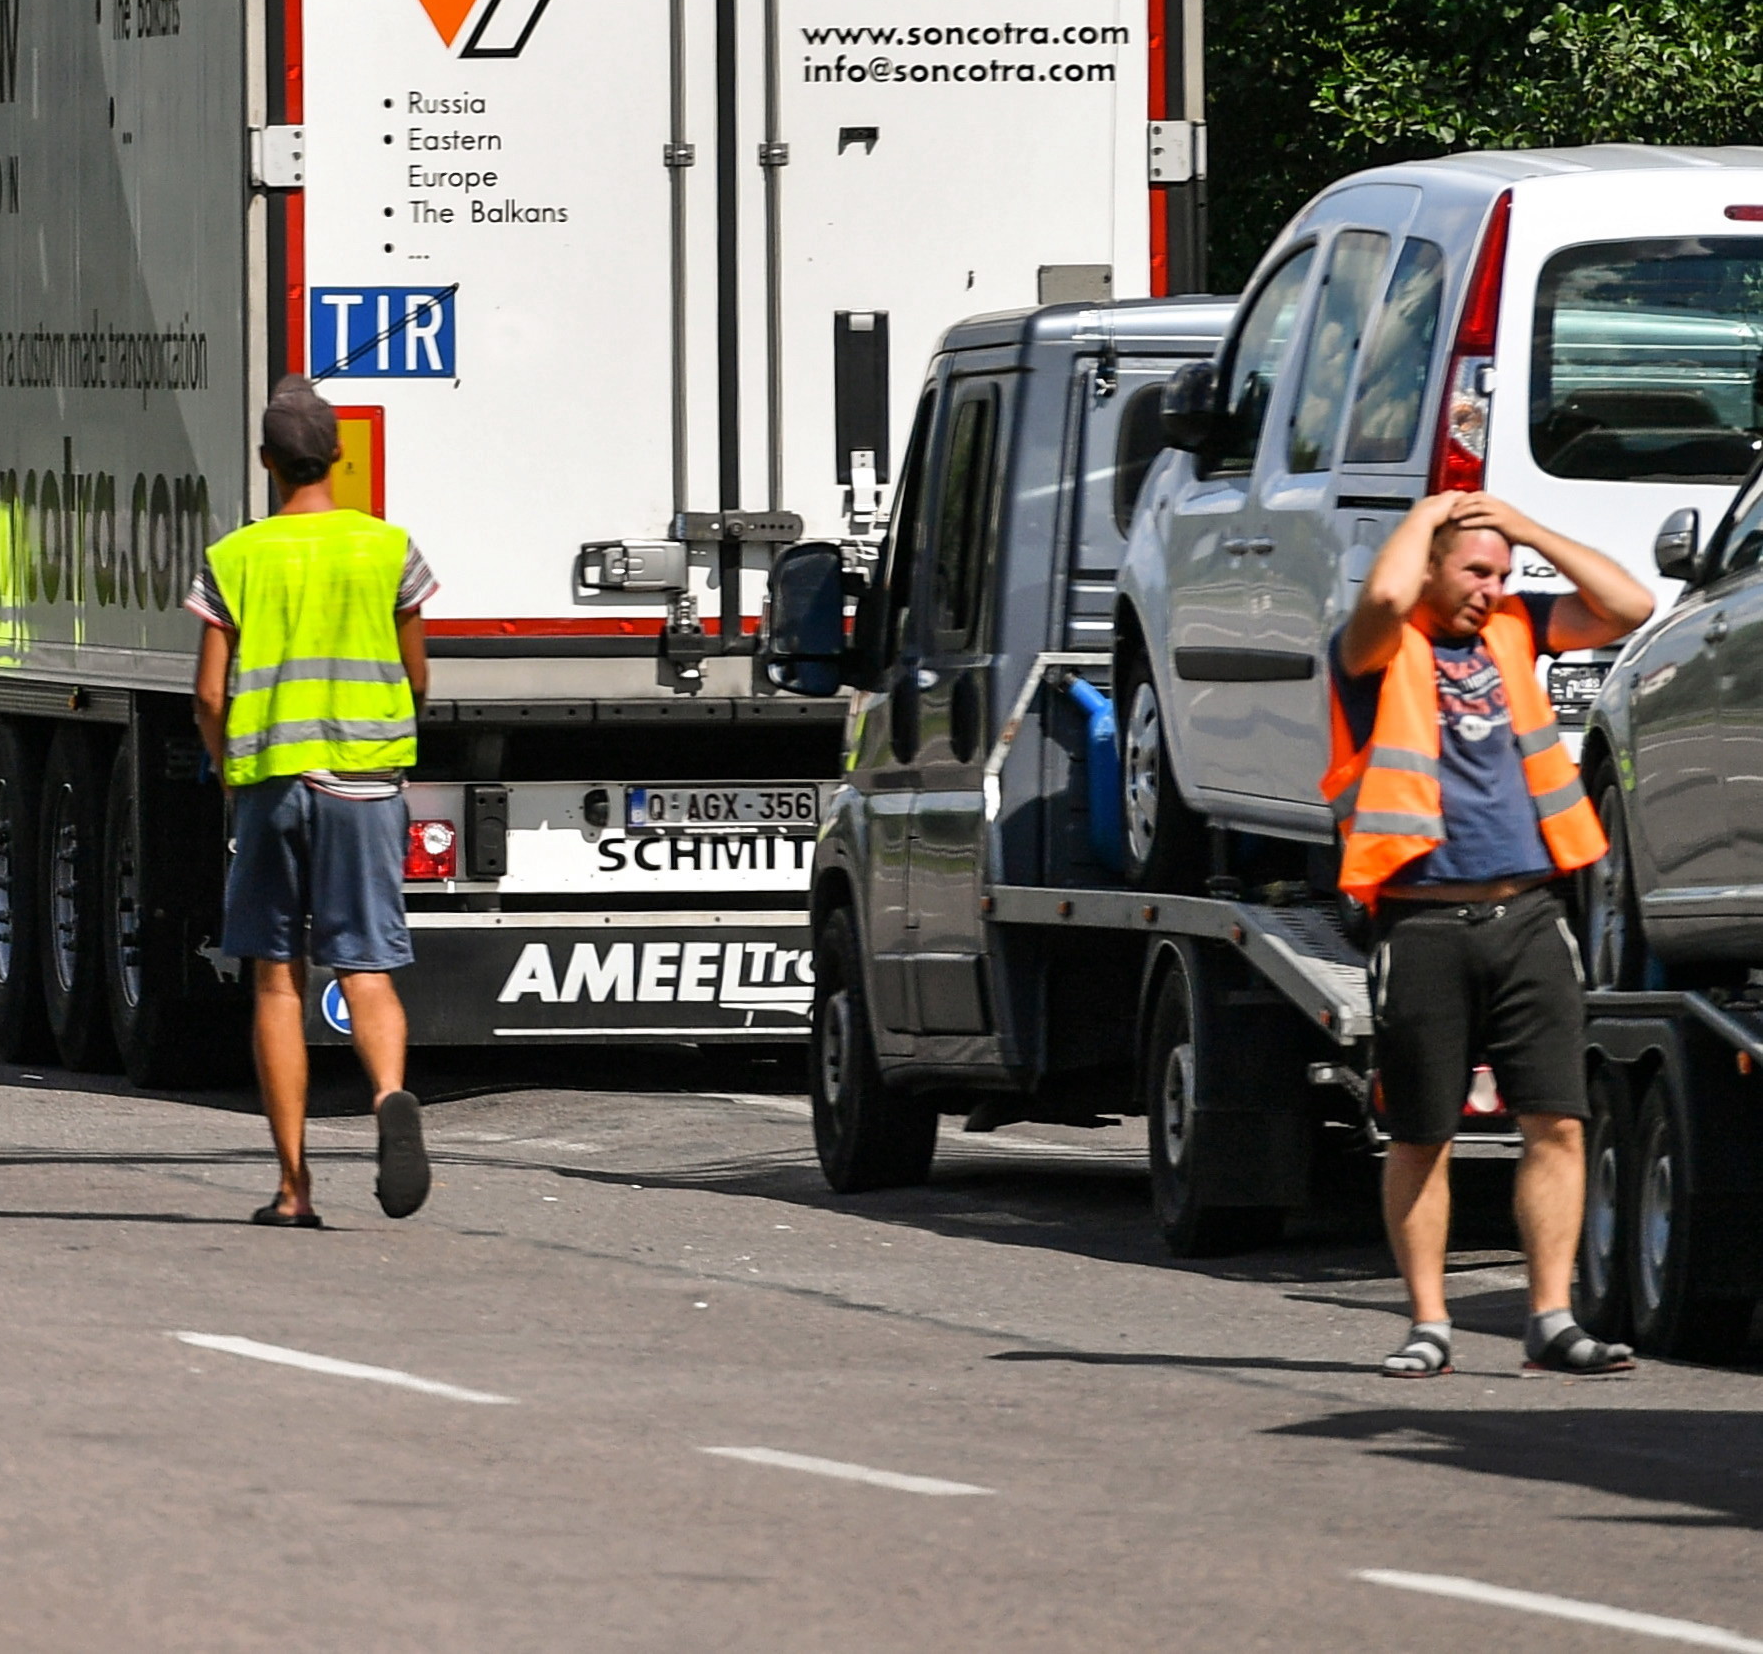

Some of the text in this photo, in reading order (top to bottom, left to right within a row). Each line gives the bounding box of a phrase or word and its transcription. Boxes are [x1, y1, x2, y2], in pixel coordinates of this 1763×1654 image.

[801, 22, 1130, 46] www.soncotra.com
[803, 53, 1116, 83] info@soncotra.com
[408, 91, 486, 115] Russia
[408, 128, 502, 151] Eastern
[408, 164, 499, 193] Europe
[408, 198, 568, 224] The Balkans
[322, 295, 444, 373] TIR
[19, 321, 66, 389] custom
[69, 309, 107, 389] made
[108, 312, 209, 411] transportation
[598, 835, 816, 872] SCHMIT
[497, 942, 743, 1003] AMEEL
